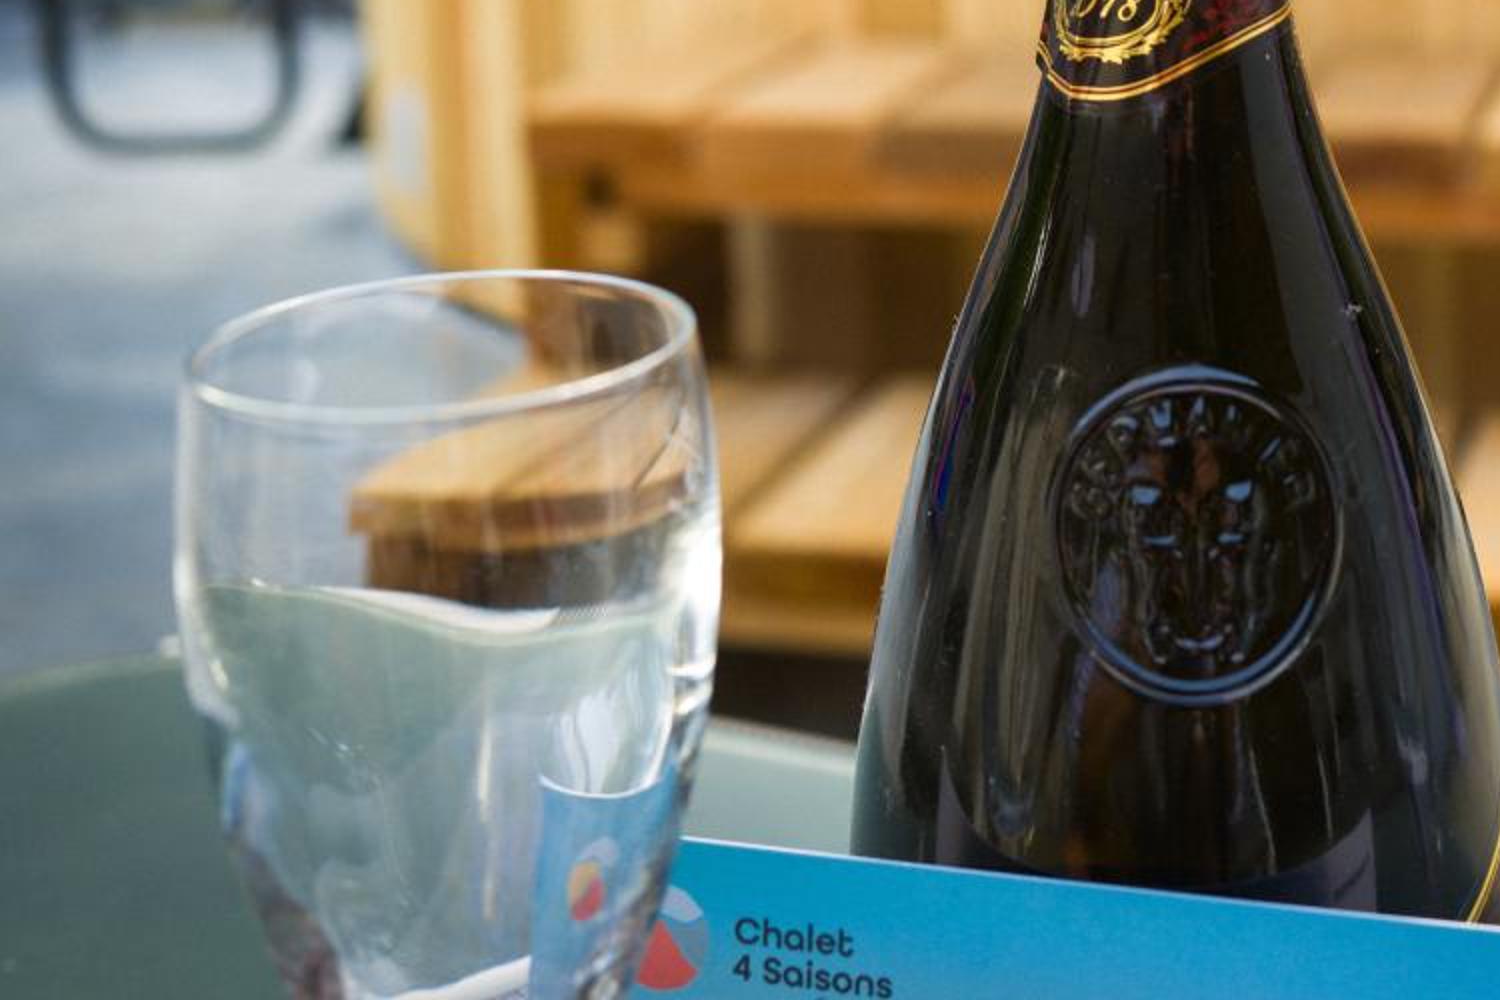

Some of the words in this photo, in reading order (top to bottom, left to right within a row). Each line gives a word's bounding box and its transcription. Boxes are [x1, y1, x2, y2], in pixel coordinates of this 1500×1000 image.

[734, 917, 855, 958] Chalet
[732, 953, 752, 982] 4
[763, 956, 894, 999] Saisons
